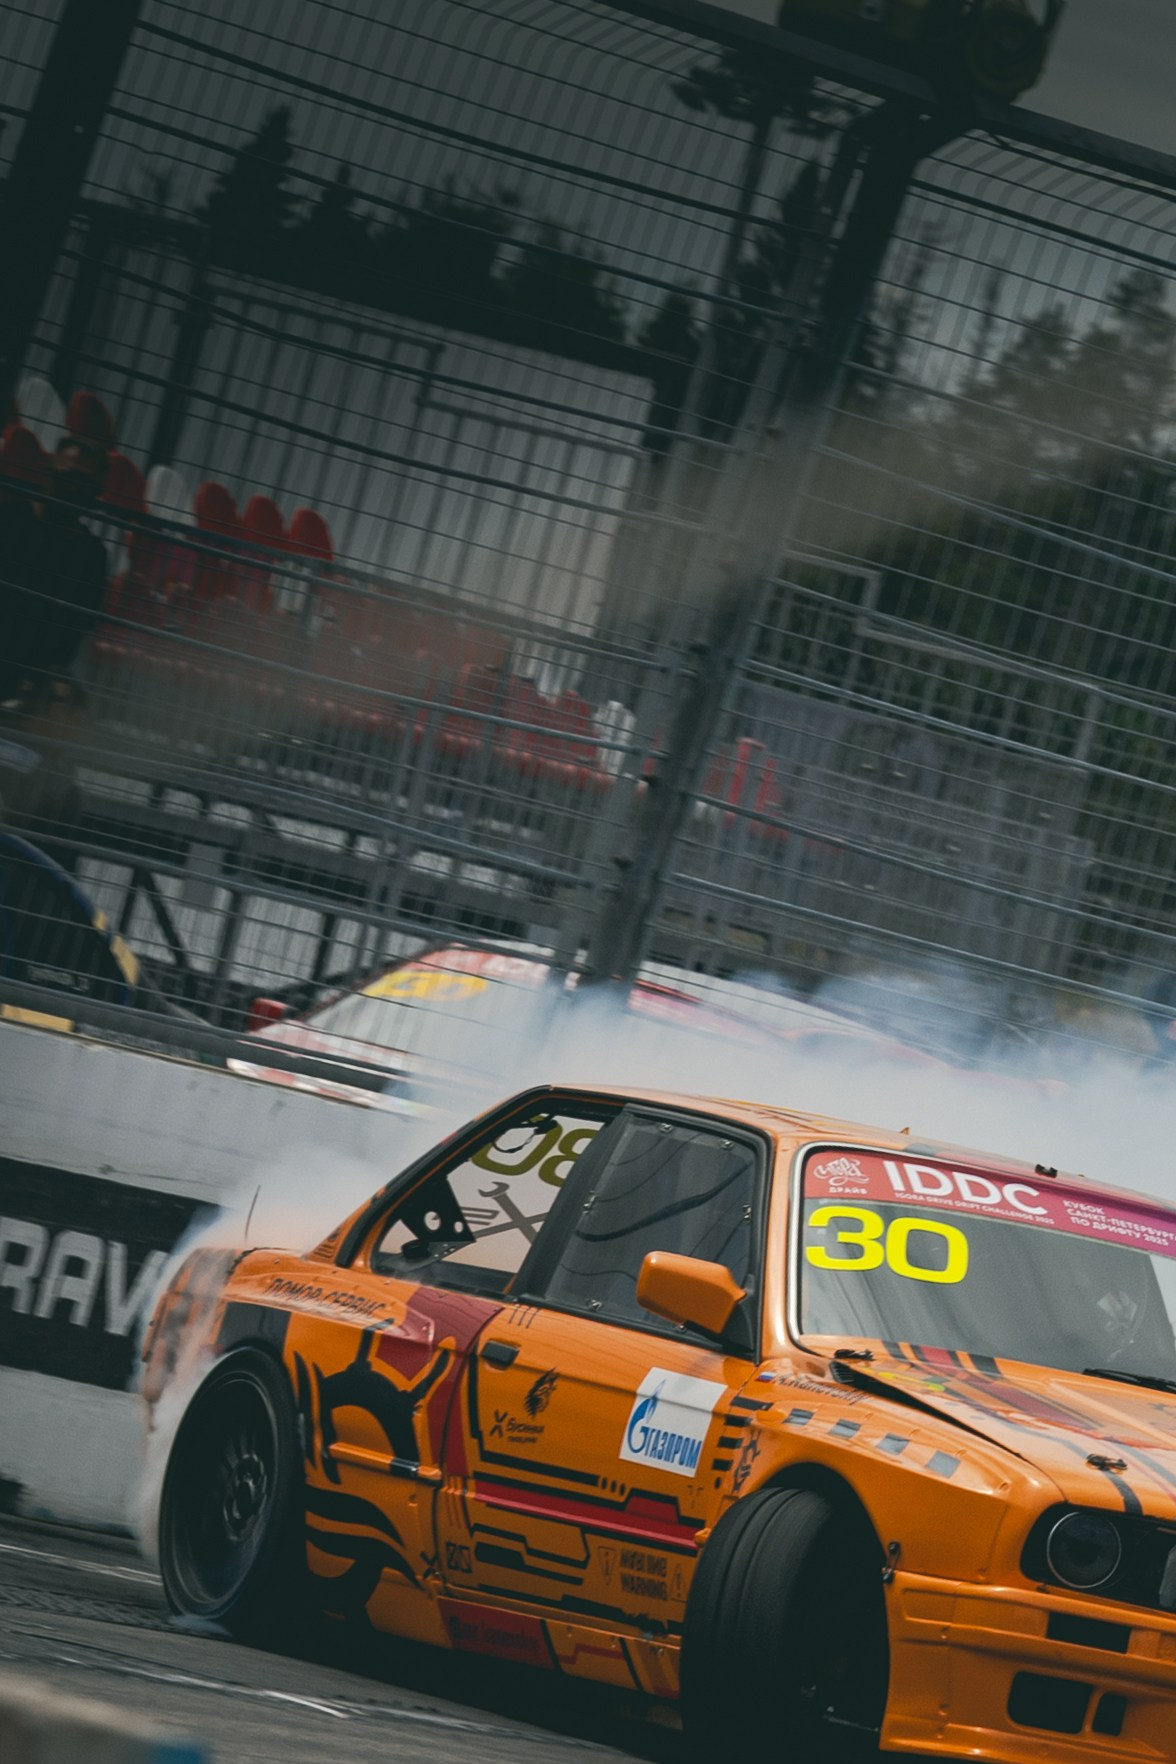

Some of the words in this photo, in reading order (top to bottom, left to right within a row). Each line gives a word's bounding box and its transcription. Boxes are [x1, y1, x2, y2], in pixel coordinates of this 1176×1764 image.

[883, 1161, 1049, 1216] IDDC
[1062, 1200, 1104, 1215] КУБОК
[805, 1205, 969, 1284] 30
[1070, 1216, 1090, 1228] ПО
[1092, 1221, 1142, 1240] ДРИФТУ
[1143, 1233, 1169, 1247] 2025
[642, 1427, 702, 1469] ГАЗПРОМ
